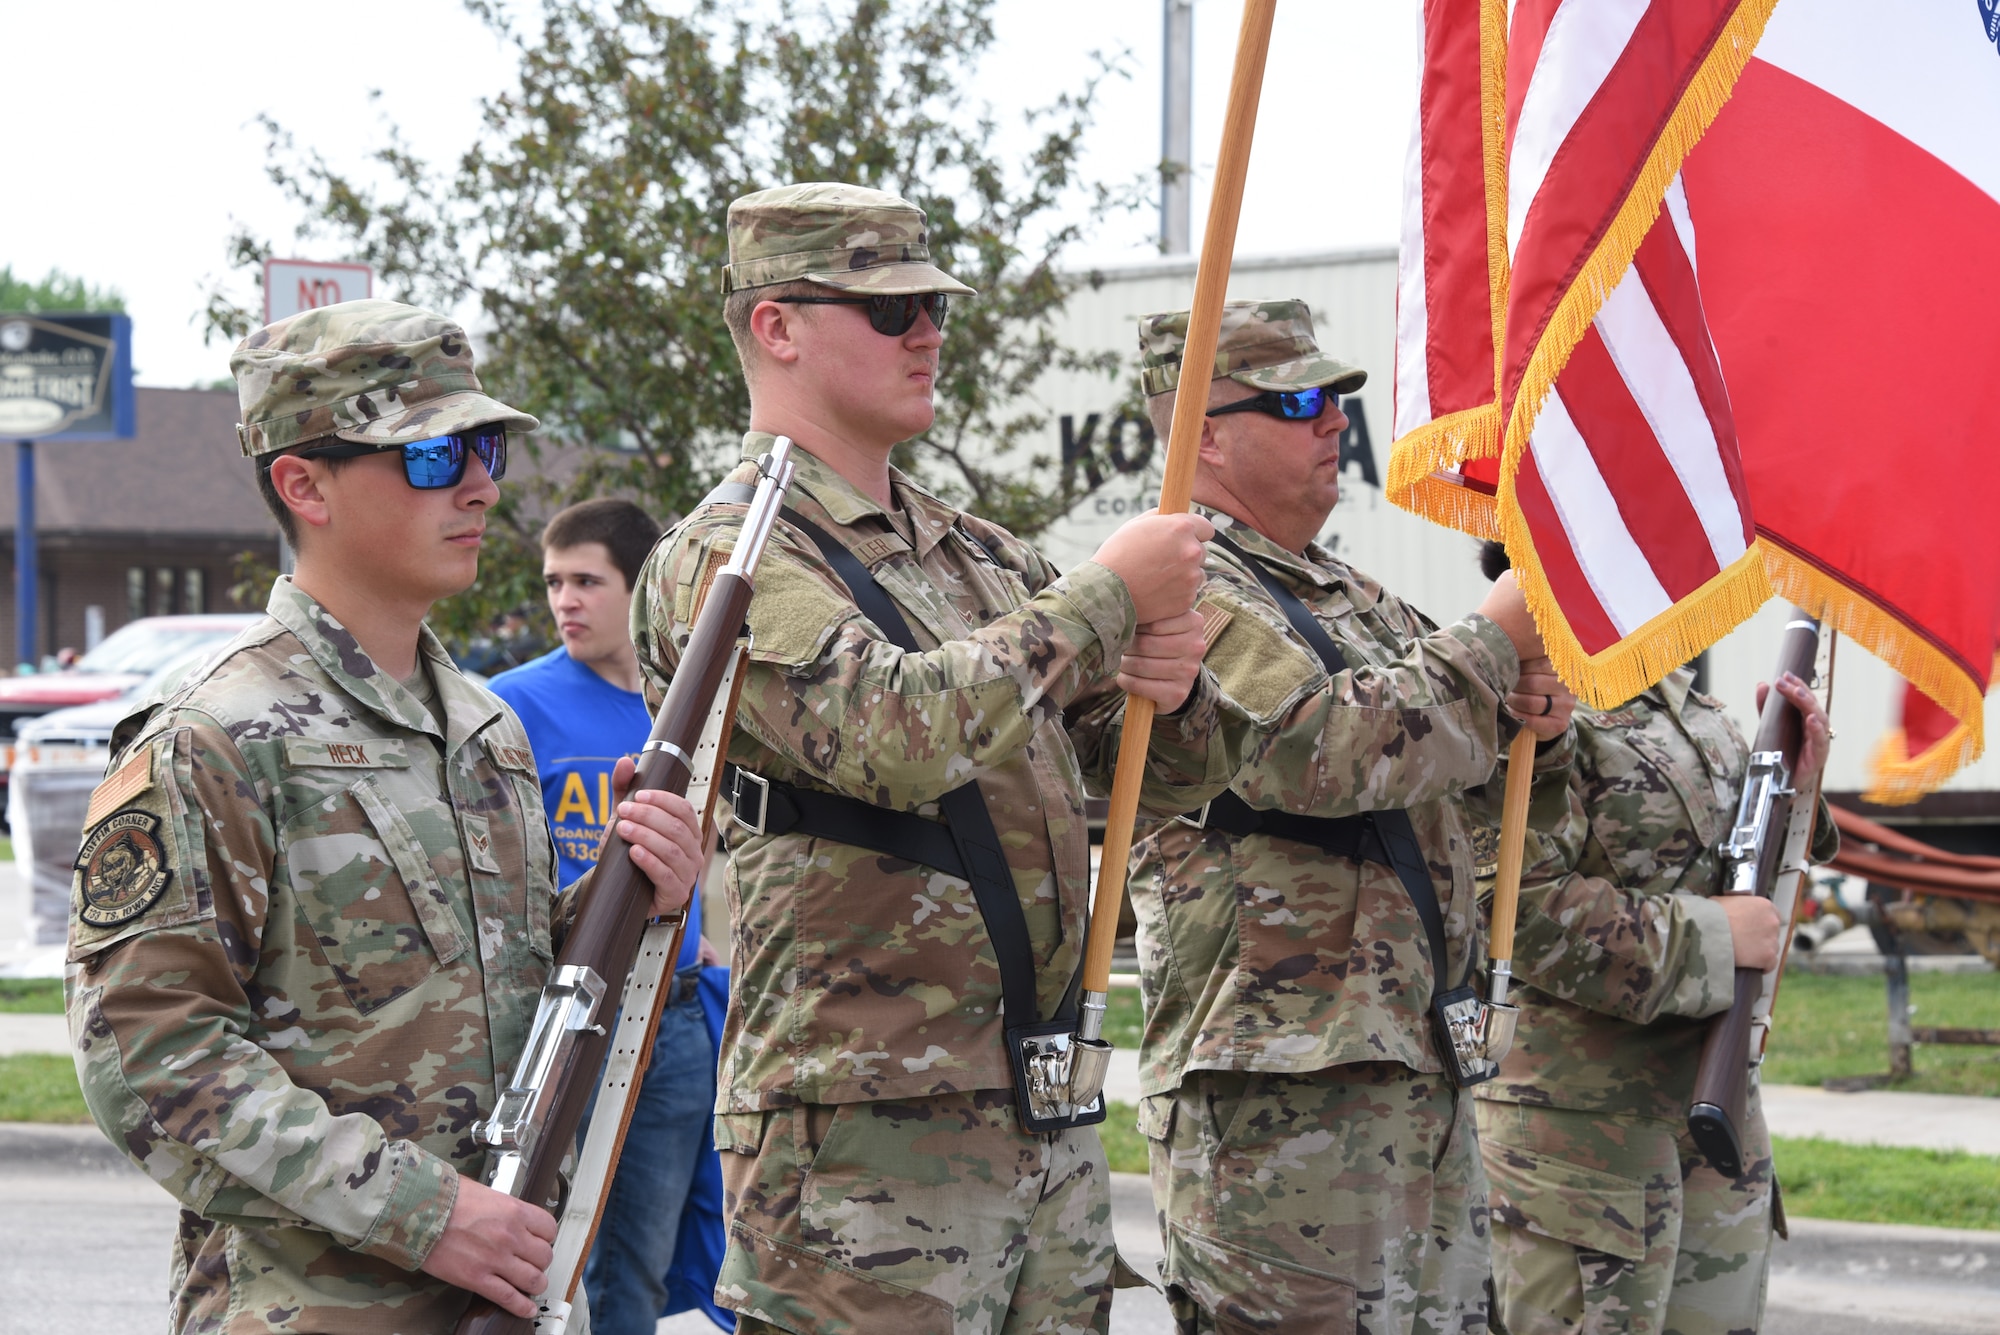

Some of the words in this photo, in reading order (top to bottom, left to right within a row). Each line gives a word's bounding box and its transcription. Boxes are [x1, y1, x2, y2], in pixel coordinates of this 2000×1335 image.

[298, 278, 342, 309] NO
[858, 538, 892, 565] LER
[326, 744, 370, 764] HECK
[554, 773, 609, 825] AI
[82, 825, 111, 859] COFFIN
[112, 815, 149, 829] CORNER
[87, 909, 101, 920] 133
[122, 898, 149, 917] IOWA
[149, 876, 164, 899] ANG
